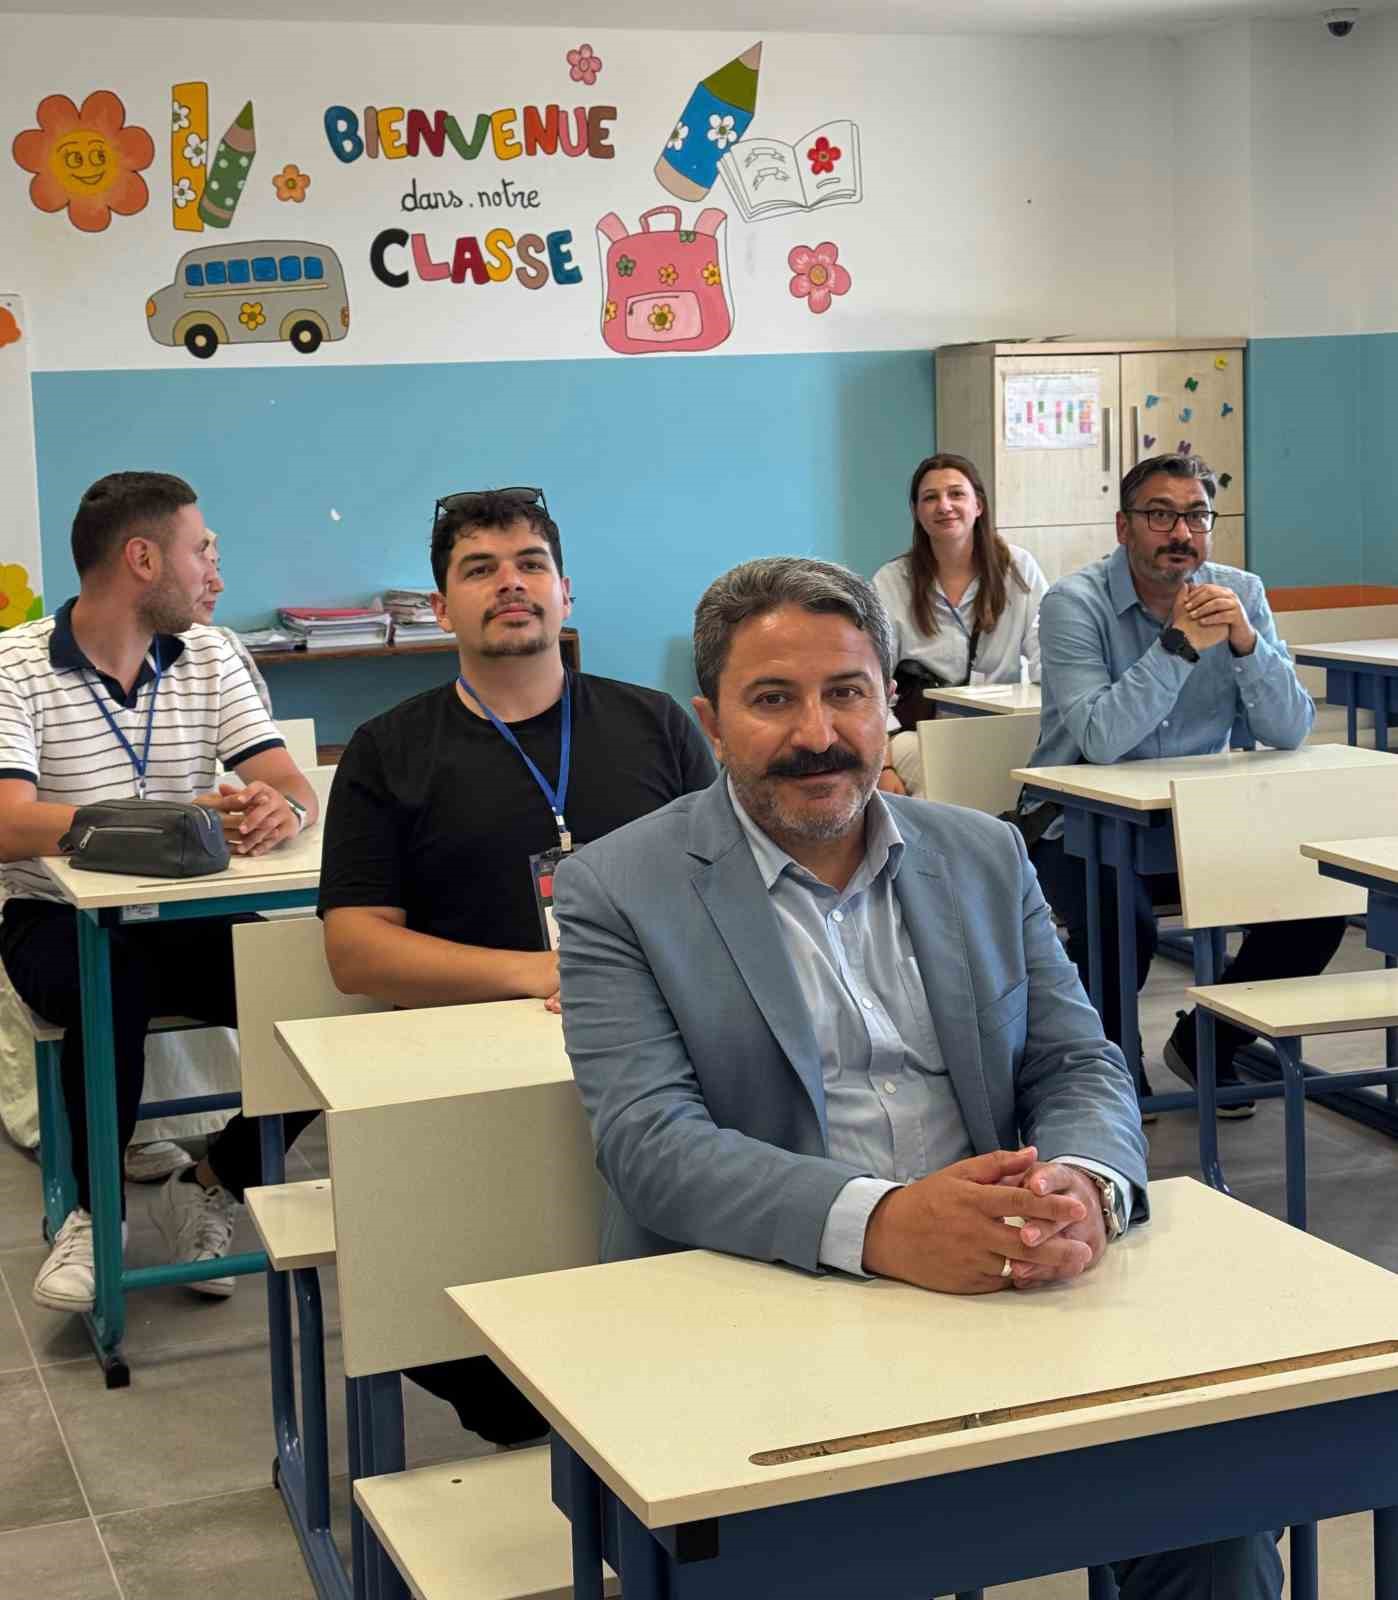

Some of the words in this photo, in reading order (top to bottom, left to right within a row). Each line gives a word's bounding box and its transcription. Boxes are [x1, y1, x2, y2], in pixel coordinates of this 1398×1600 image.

[324, 104, 617, 163] BIENVENUE
[479, 178, 541, 210] notre
[370, 228, 583, 290] CLASSE
